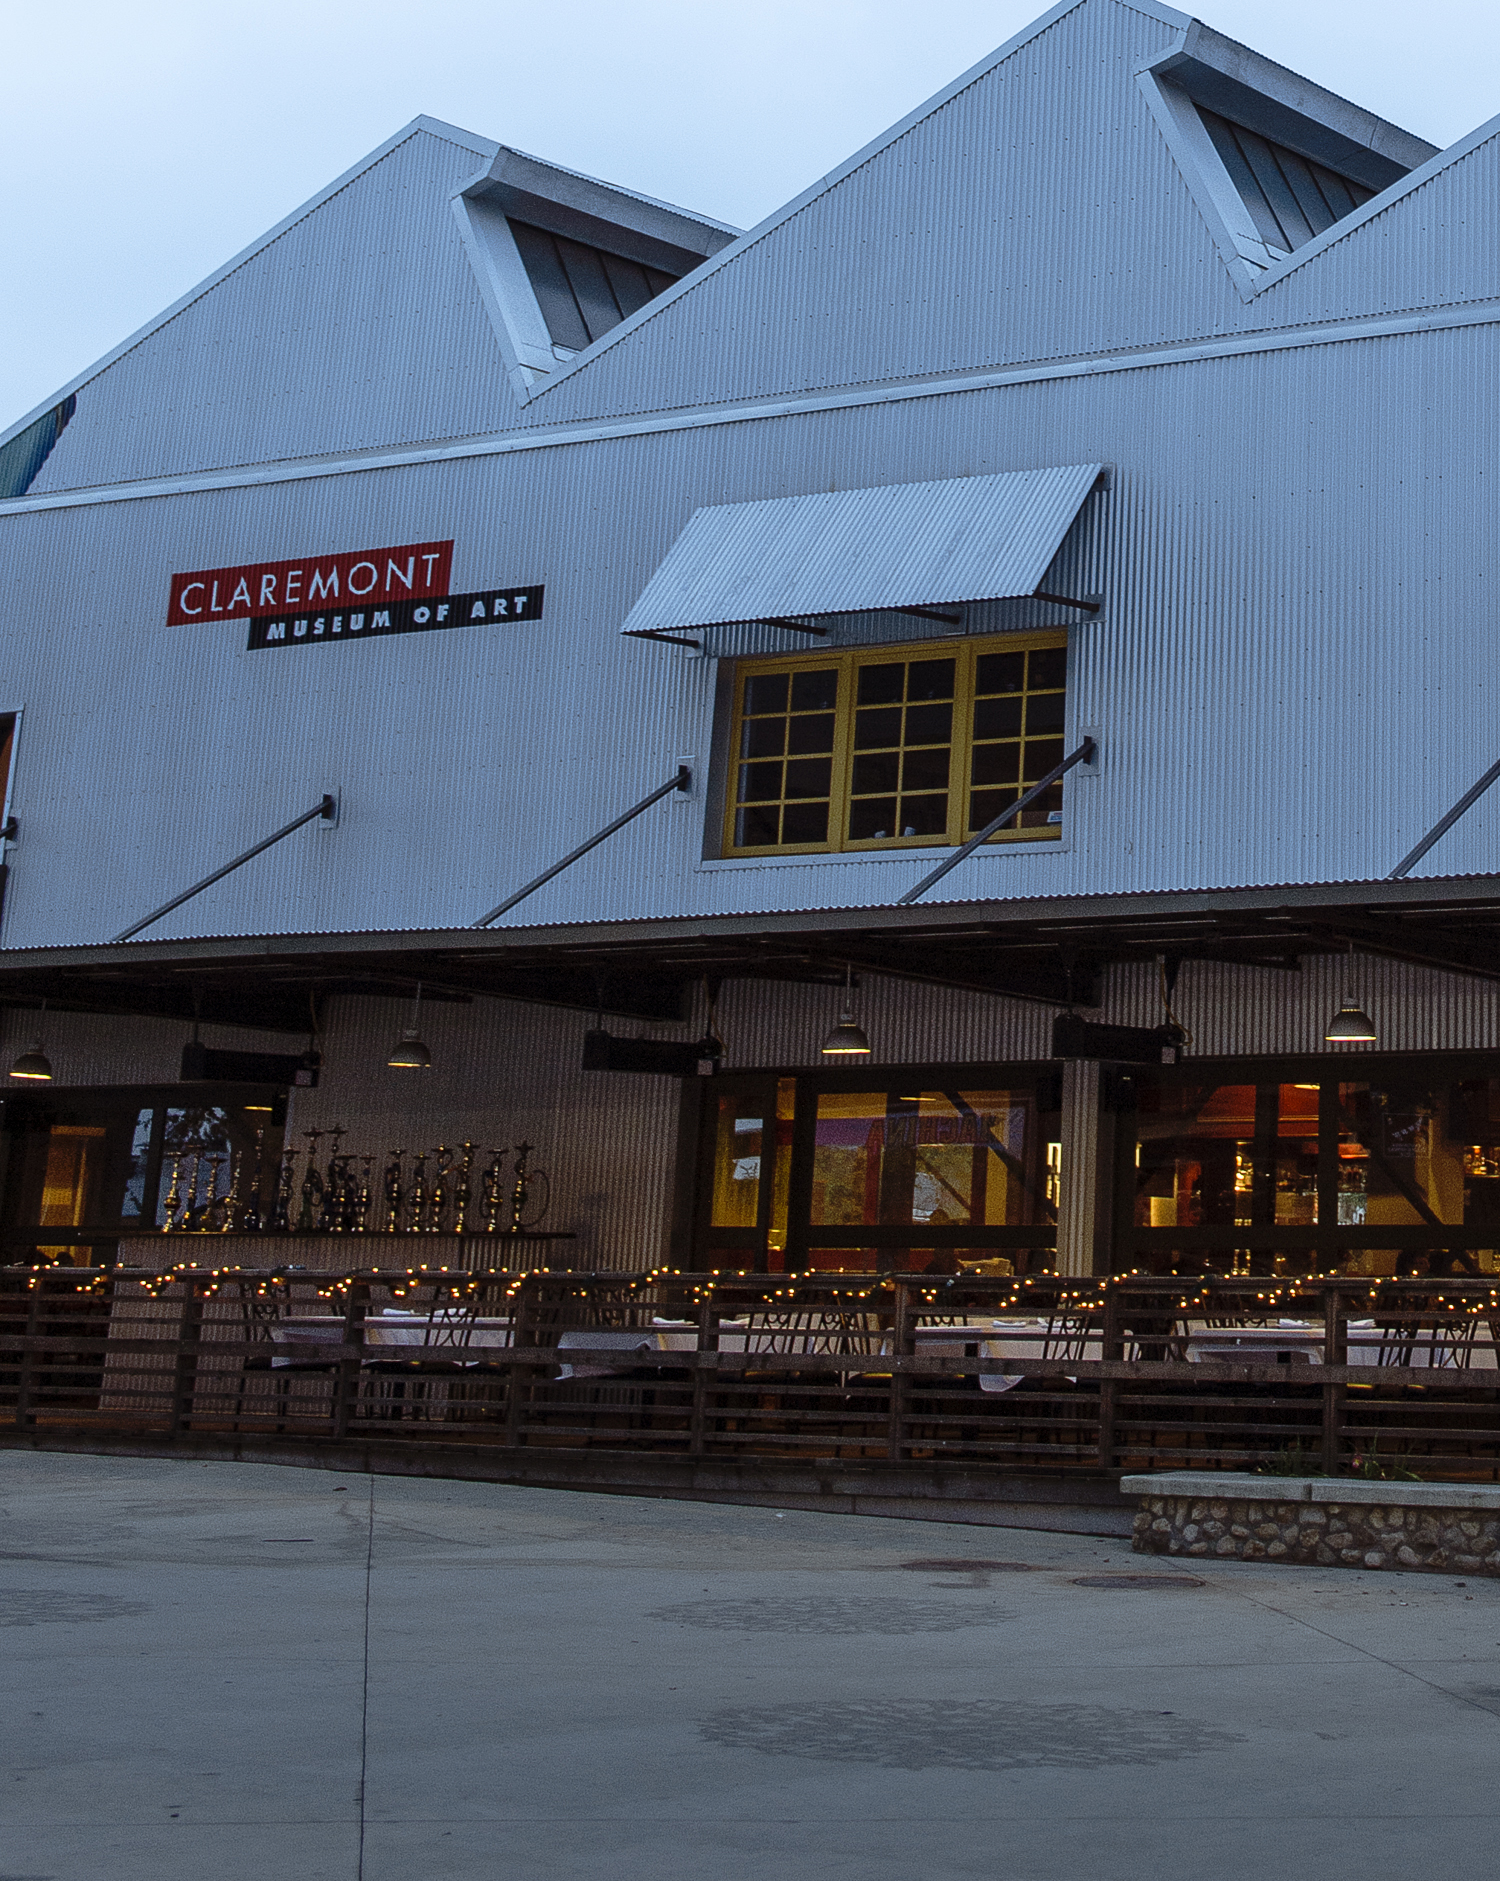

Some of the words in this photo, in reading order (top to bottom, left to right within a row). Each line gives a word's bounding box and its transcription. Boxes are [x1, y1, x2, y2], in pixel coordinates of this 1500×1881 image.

[179, 553, 441, 615] CLAREMONT
[266, 609, 391, 640] MUSEUM
[413, 604, 450, 624] OF
[470, 595, 529, 619] ART
